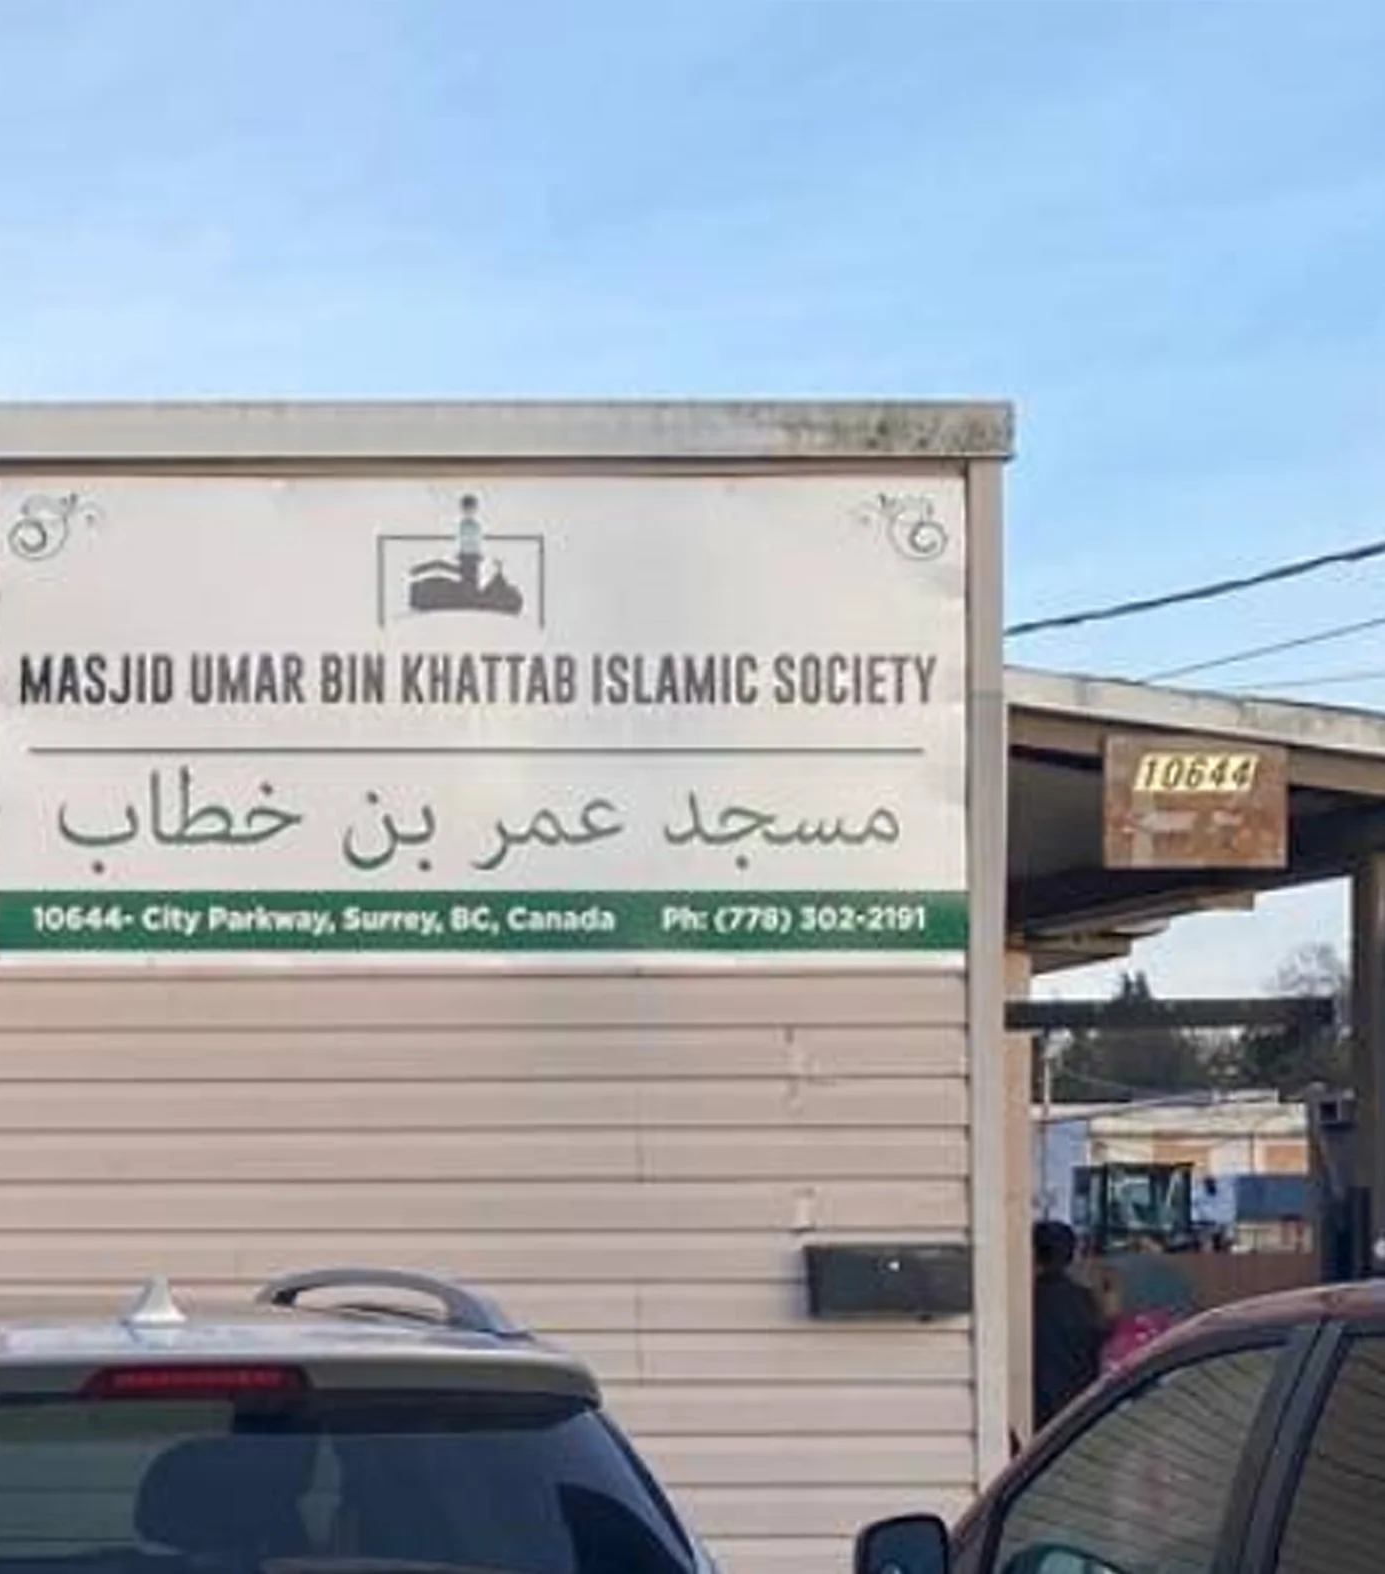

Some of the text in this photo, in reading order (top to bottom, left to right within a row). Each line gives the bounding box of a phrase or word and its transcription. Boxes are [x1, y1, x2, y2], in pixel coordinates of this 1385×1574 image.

[18, 652, 937, 706] MASJID UMAR BIN KHATTAB ISLAMIC SOCIETY
[1144, 756, 1251, 788] 10644
[56, 766, 900, 874] مسجد عمر بن خطاب
[33, 905, 616, 936] 10644- City Parkway, Surrey, BC, Canada
[662, 905, 927, 934] Ph: (778) 302-2191
